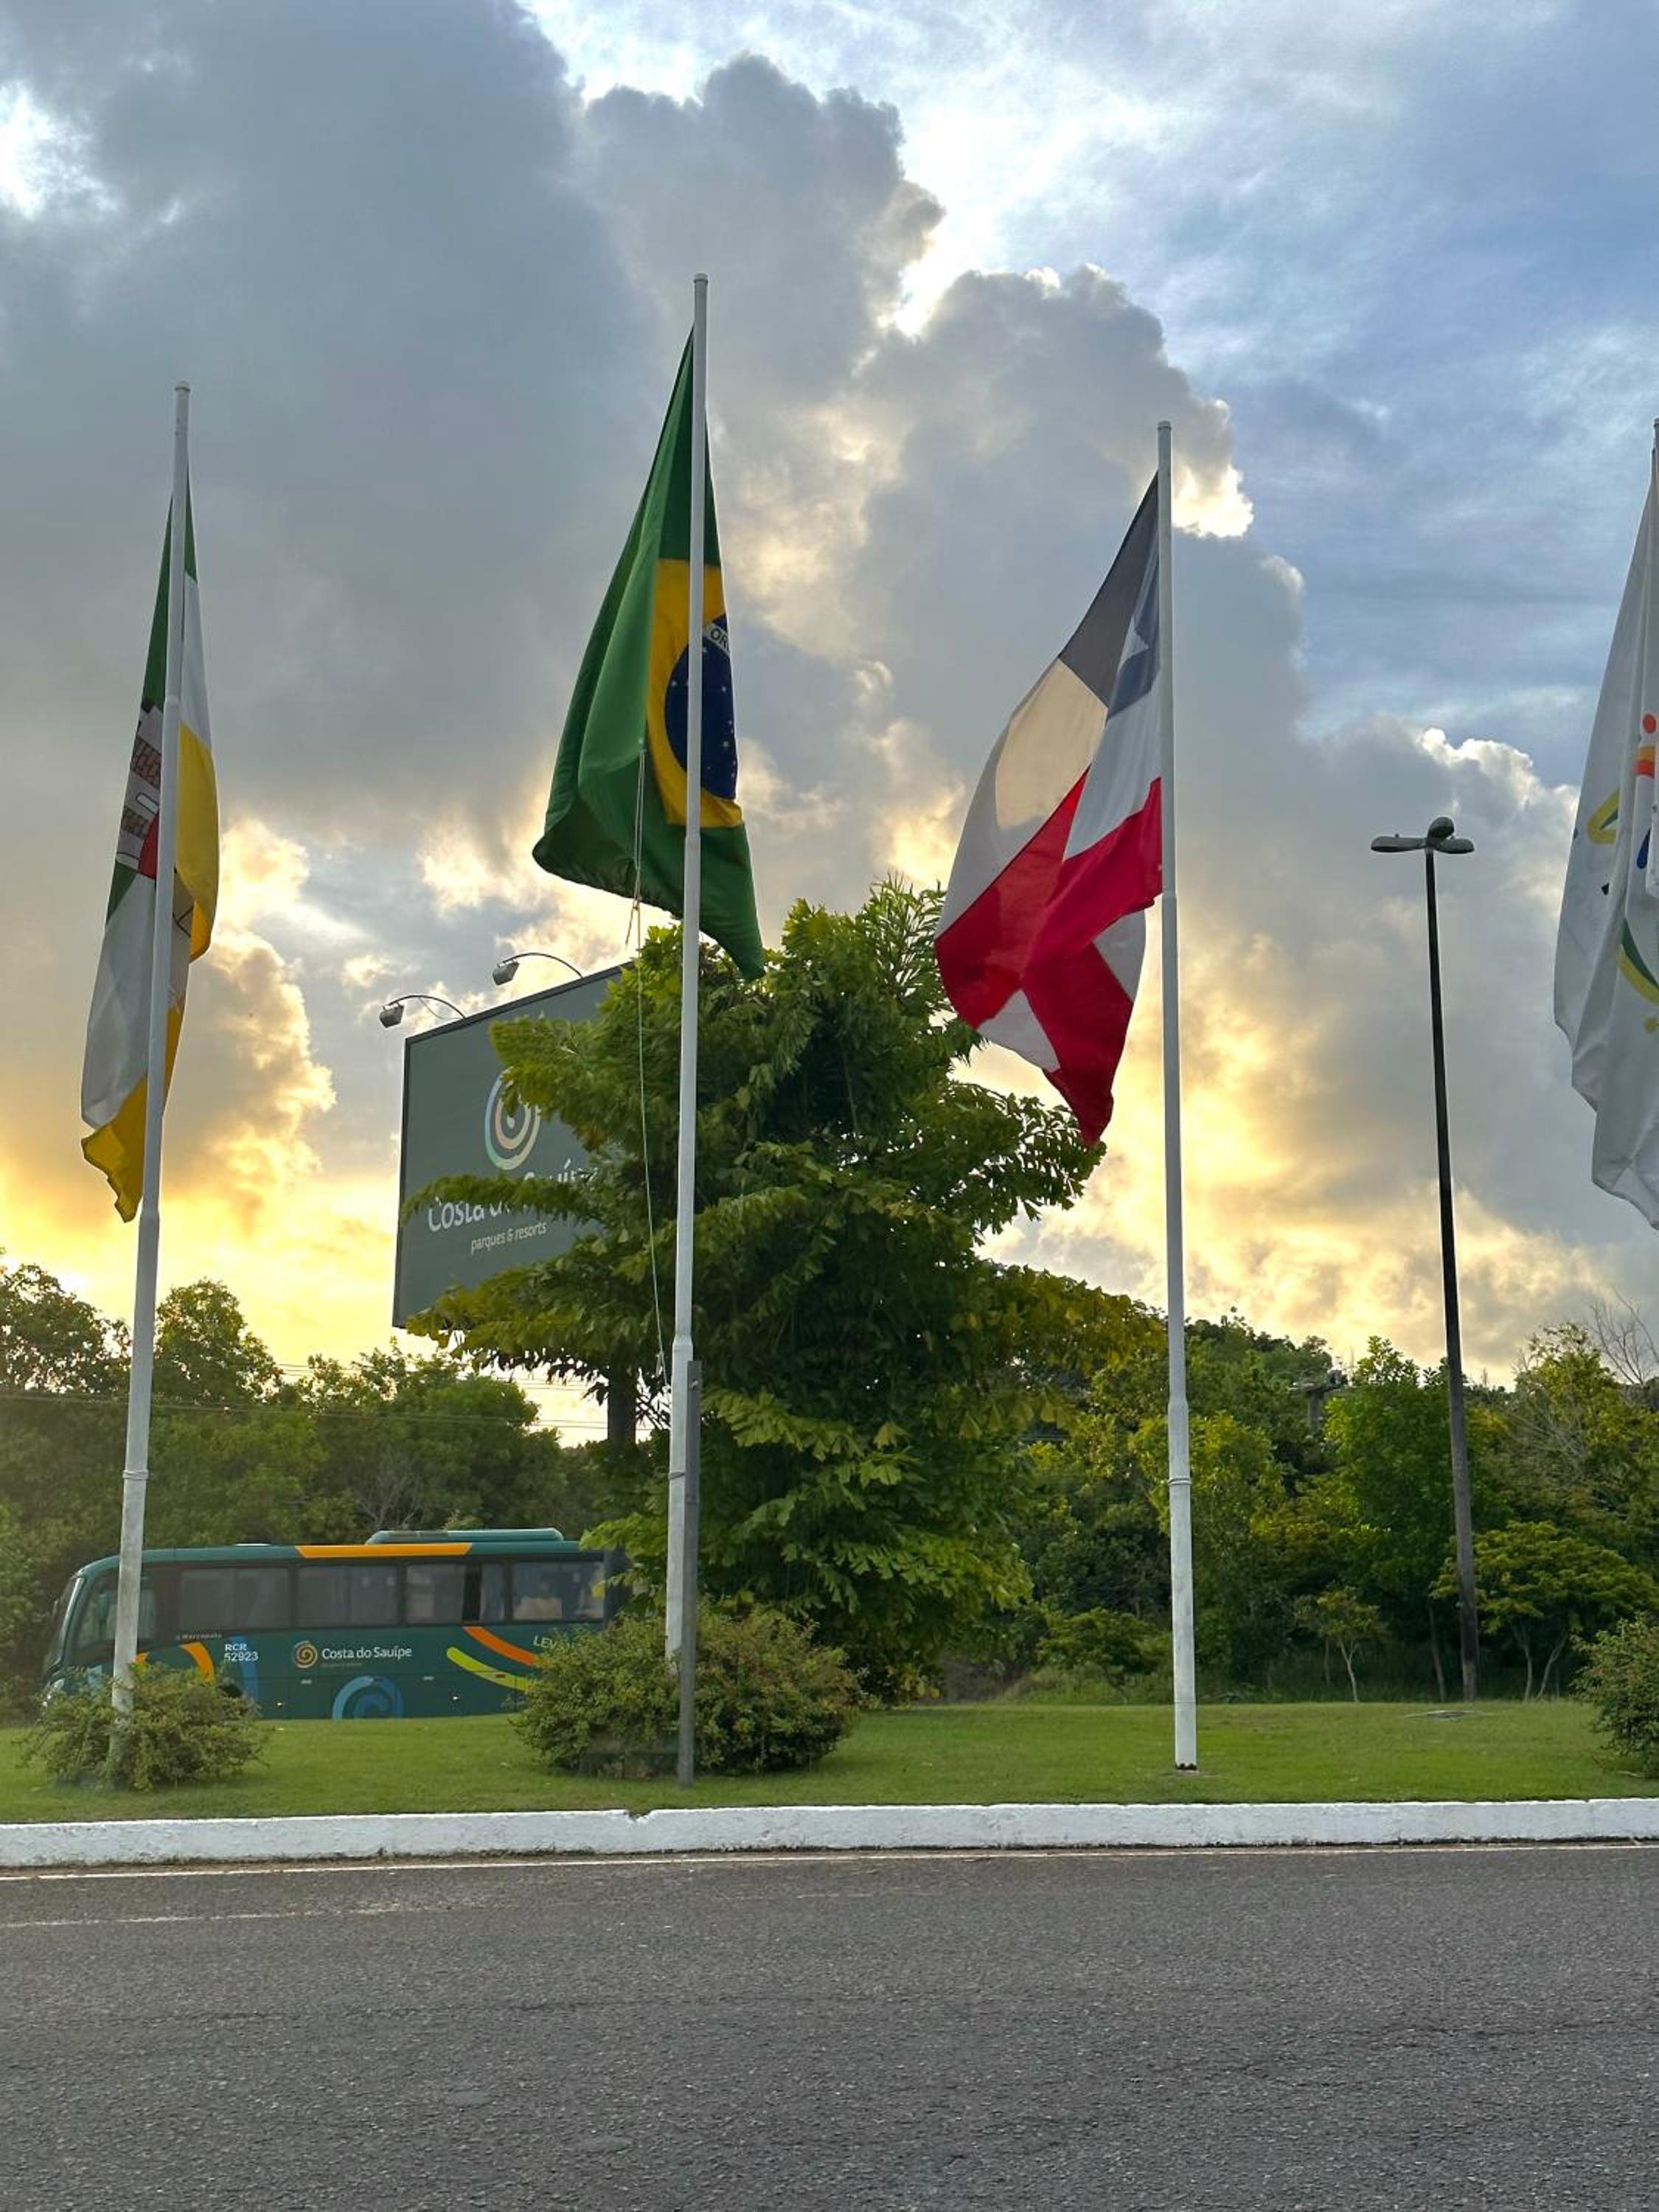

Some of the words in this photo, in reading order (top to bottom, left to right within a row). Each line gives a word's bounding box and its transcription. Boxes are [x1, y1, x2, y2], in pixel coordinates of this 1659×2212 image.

[471, 1232, 506, 1255] parques
[507, 1231, 513, 1242] &
[515, 1221, 547, 1240] resorts
[224, 1644, 247, 1652] RCR
[322, 1648, 355, 1660] Costa
[356, 1646, 372, 1659] do
[373, 1645, 412, 1660] Sauípe
[223, 1652, 259, 1662] 52923
